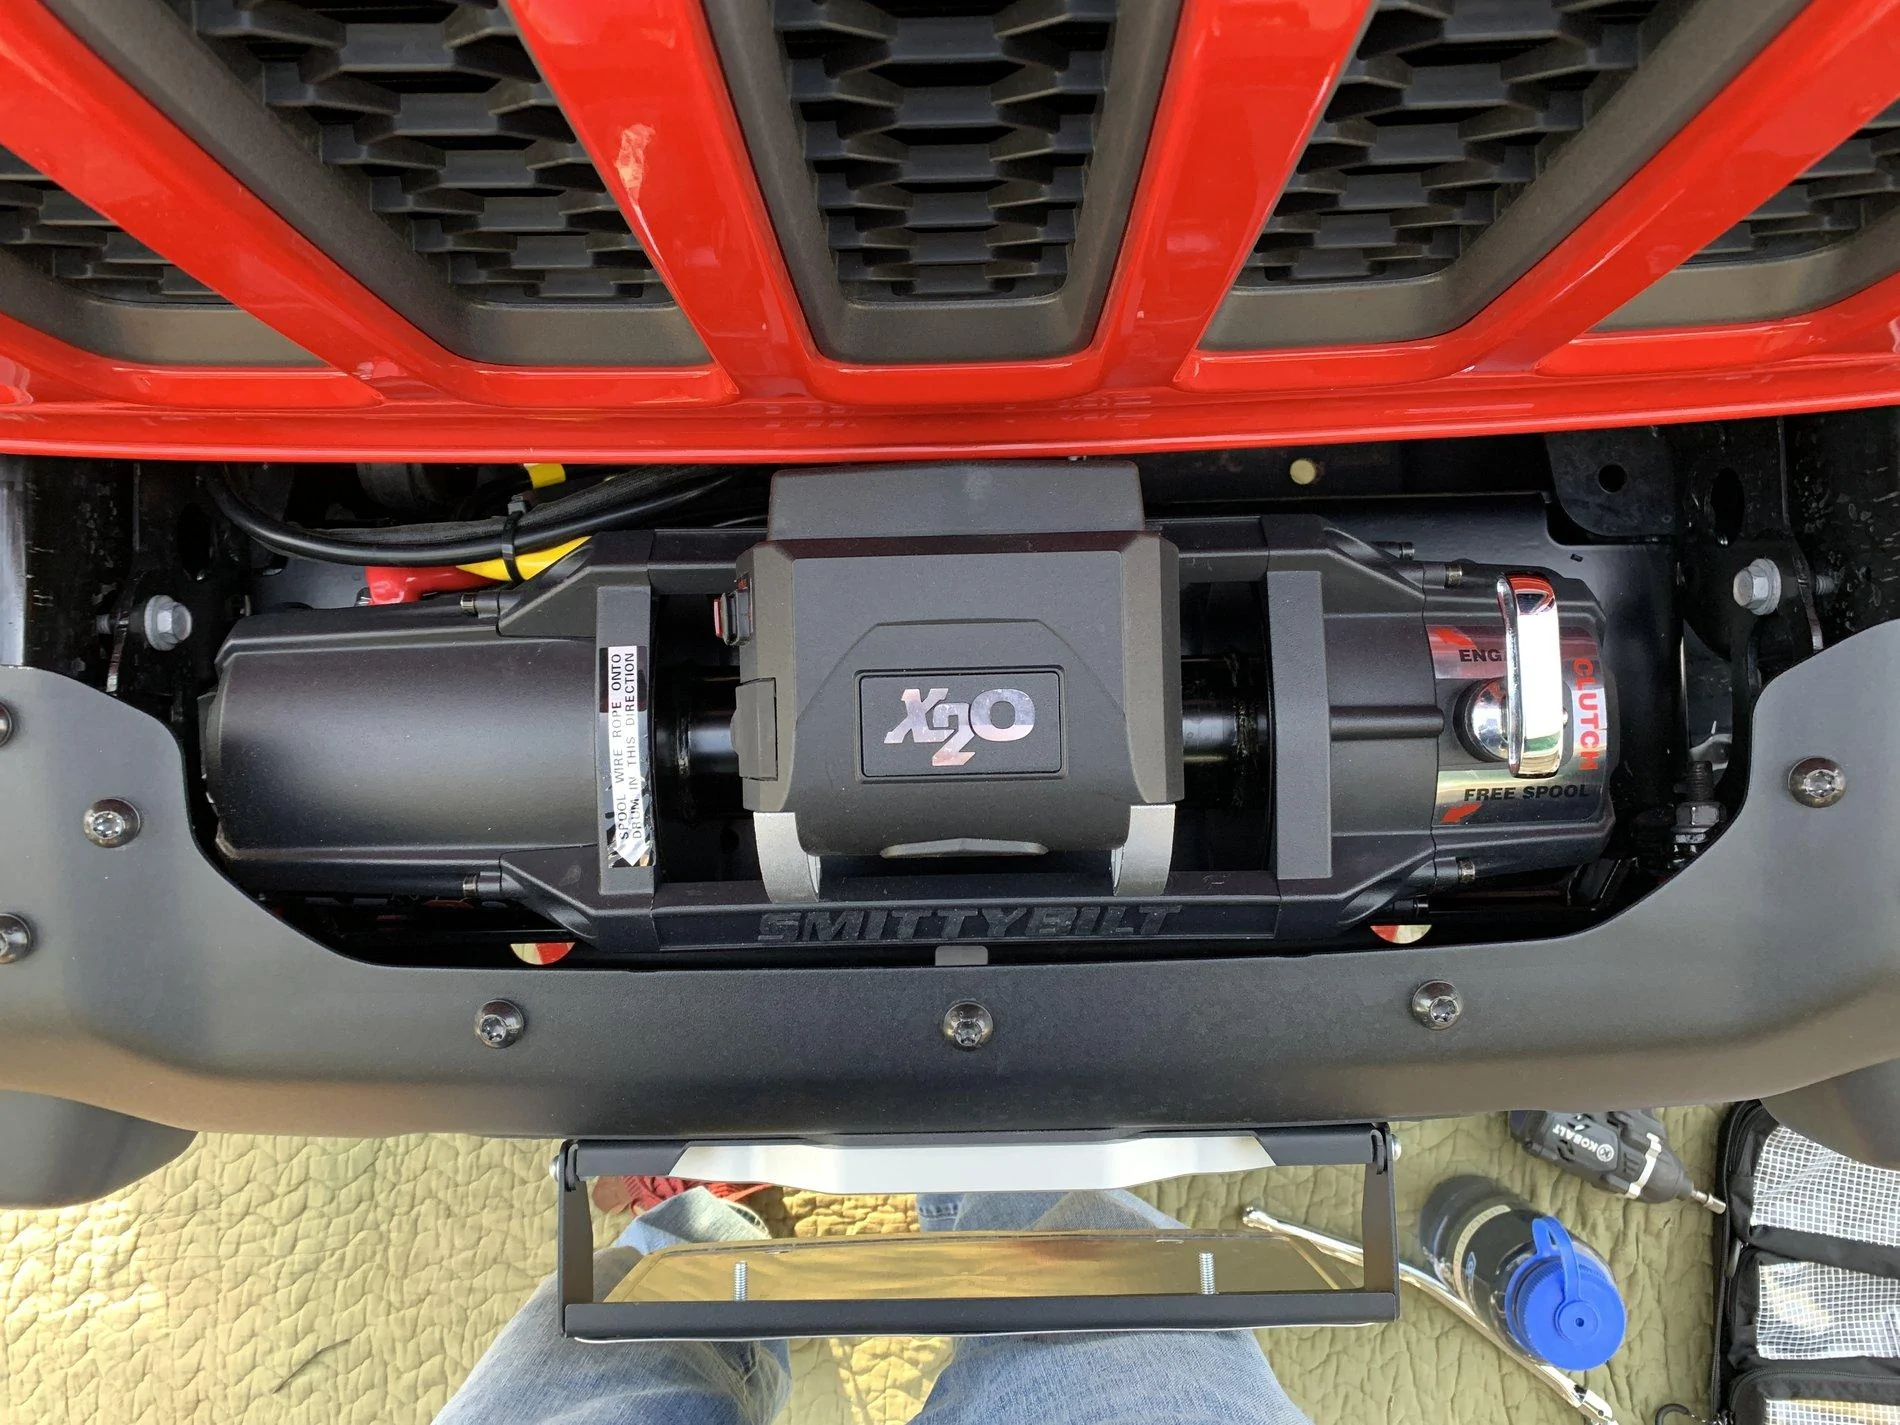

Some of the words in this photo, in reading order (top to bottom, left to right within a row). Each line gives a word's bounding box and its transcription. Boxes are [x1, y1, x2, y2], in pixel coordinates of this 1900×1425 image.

[611, 654, 622, 691] ONTO
[1459, 649, 1502, 662] ENG
[624, 653, 635, 726] DIRECTION
[612, 701, 622, 738] ROPE
[1573, 658, 1600, 770] CLUTCH
[613, 749, 624, 784] WIRE
[626, 737, 637, 767] THIS
[629, 776, 638, 790] IN
[1464, 787, 1516, 801] FREE
[1522, 784, 1589, 799] SPOOL
[617, 794, 629, 840] SPOOL
[630, 798, 642, 839] DRUM
[757, 904, 1183, 943] SMITTYBILT
[1552, 1124, 1598, 1152] KOBALT
